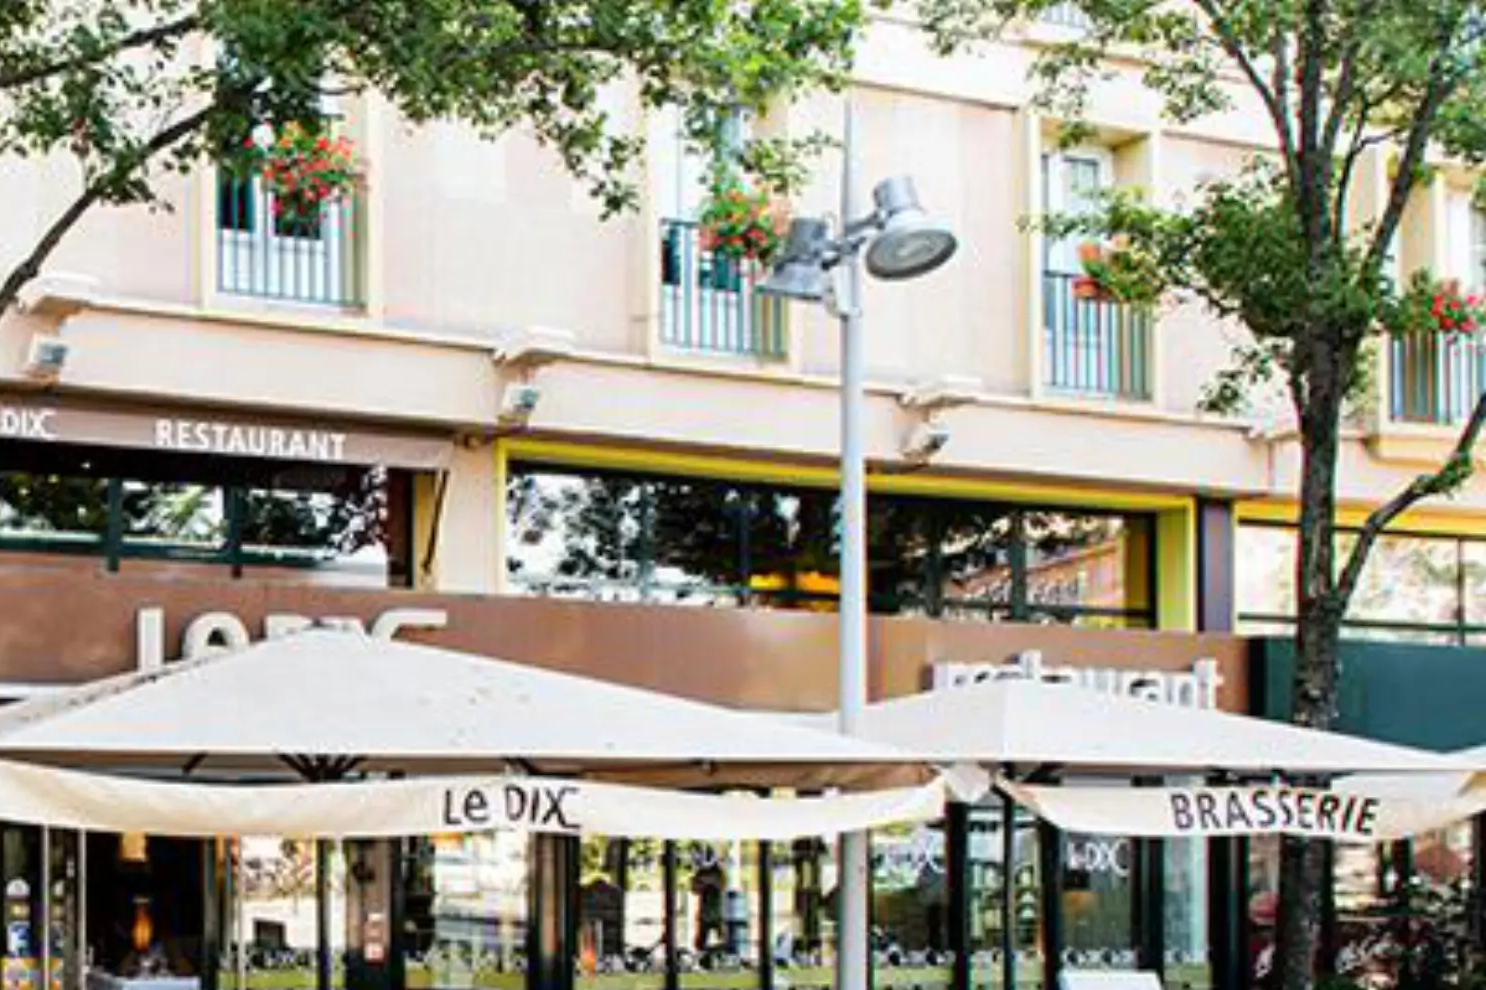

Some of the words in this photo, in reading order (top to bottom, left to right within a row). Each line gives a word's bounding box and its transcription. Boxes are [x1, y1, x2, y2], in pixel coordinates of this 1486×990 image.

[0, 408, 58, 441] DIX
[154, 417, 347, 461] RESTAURANT
[444, 787, 490, 825] Le
[504, 783, 582, 830] DIX
[1170, 789, 1381, 836] BRASSERIE
